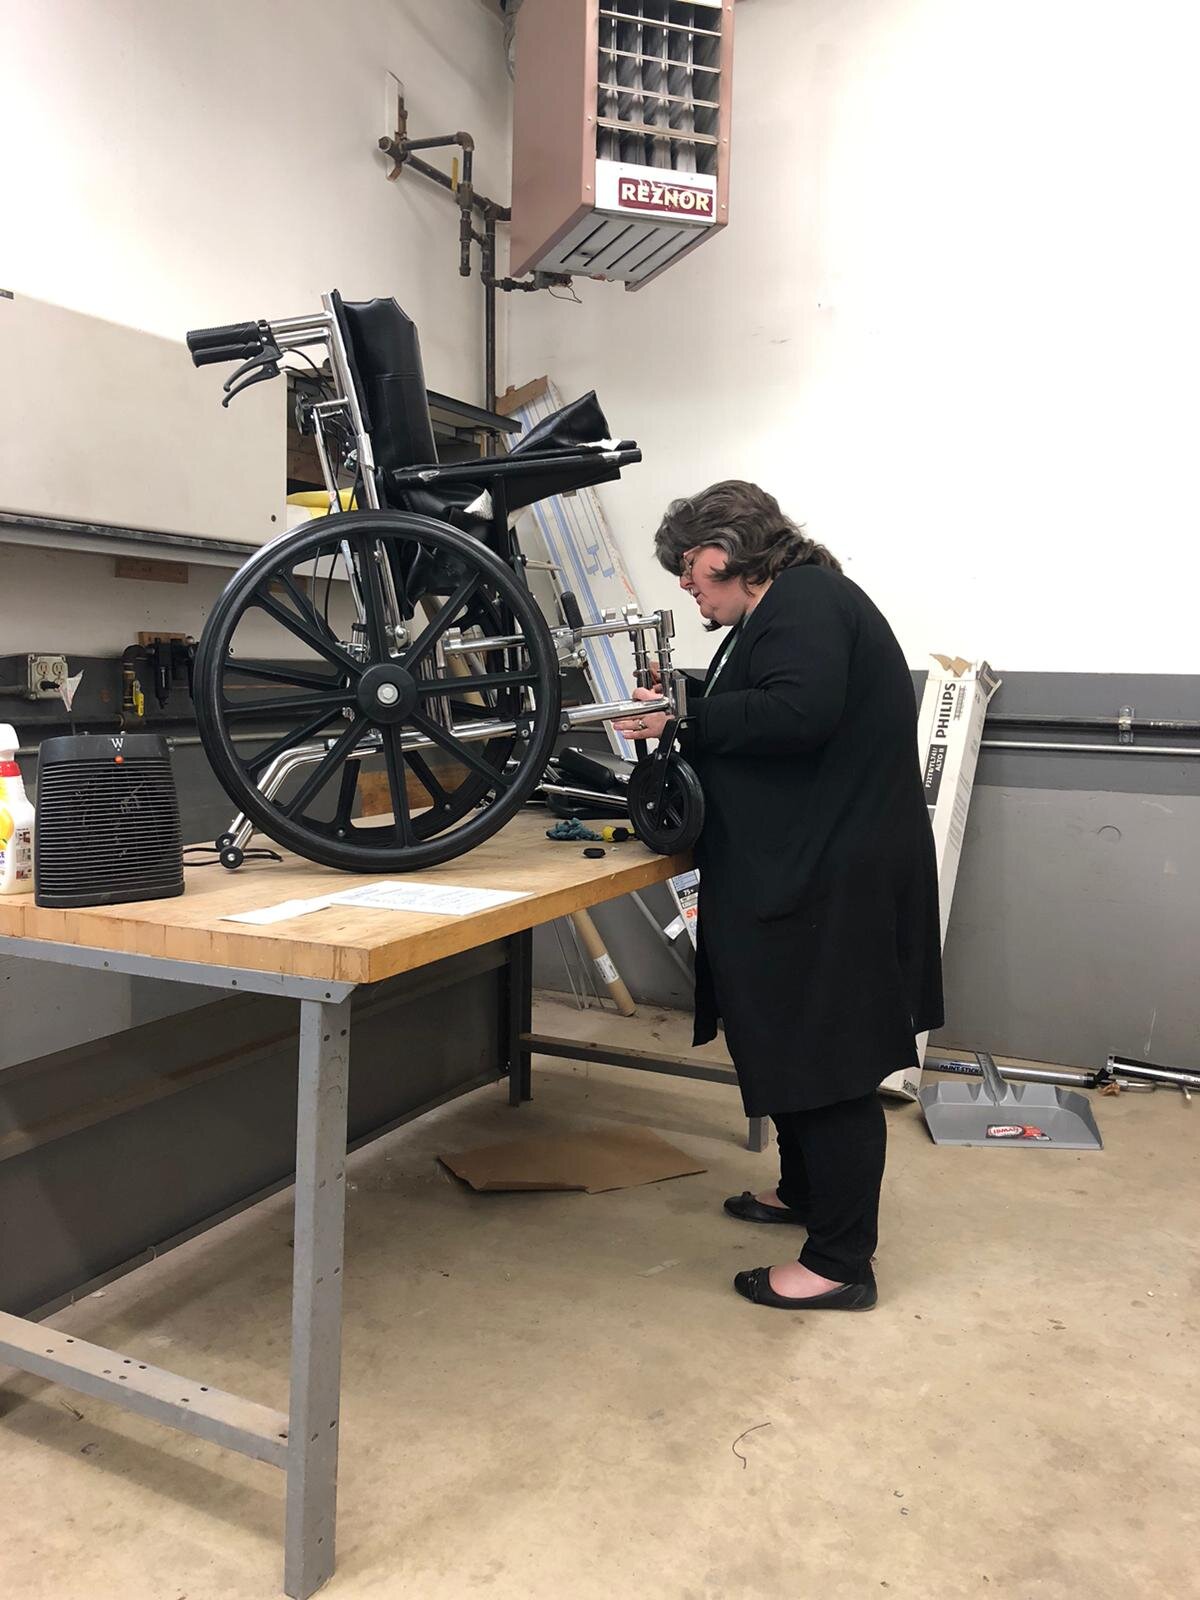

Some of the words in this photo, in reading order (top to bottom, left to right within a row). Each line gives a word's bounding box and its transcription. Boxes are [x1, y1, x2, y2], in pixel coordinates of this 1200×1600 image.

[621, 182, 710, 212] REZNOR
[935, 683, 956, 738] PHILIPS
[111, 738, 124, 749] W
[934, 753, 944, 772] ALTO
